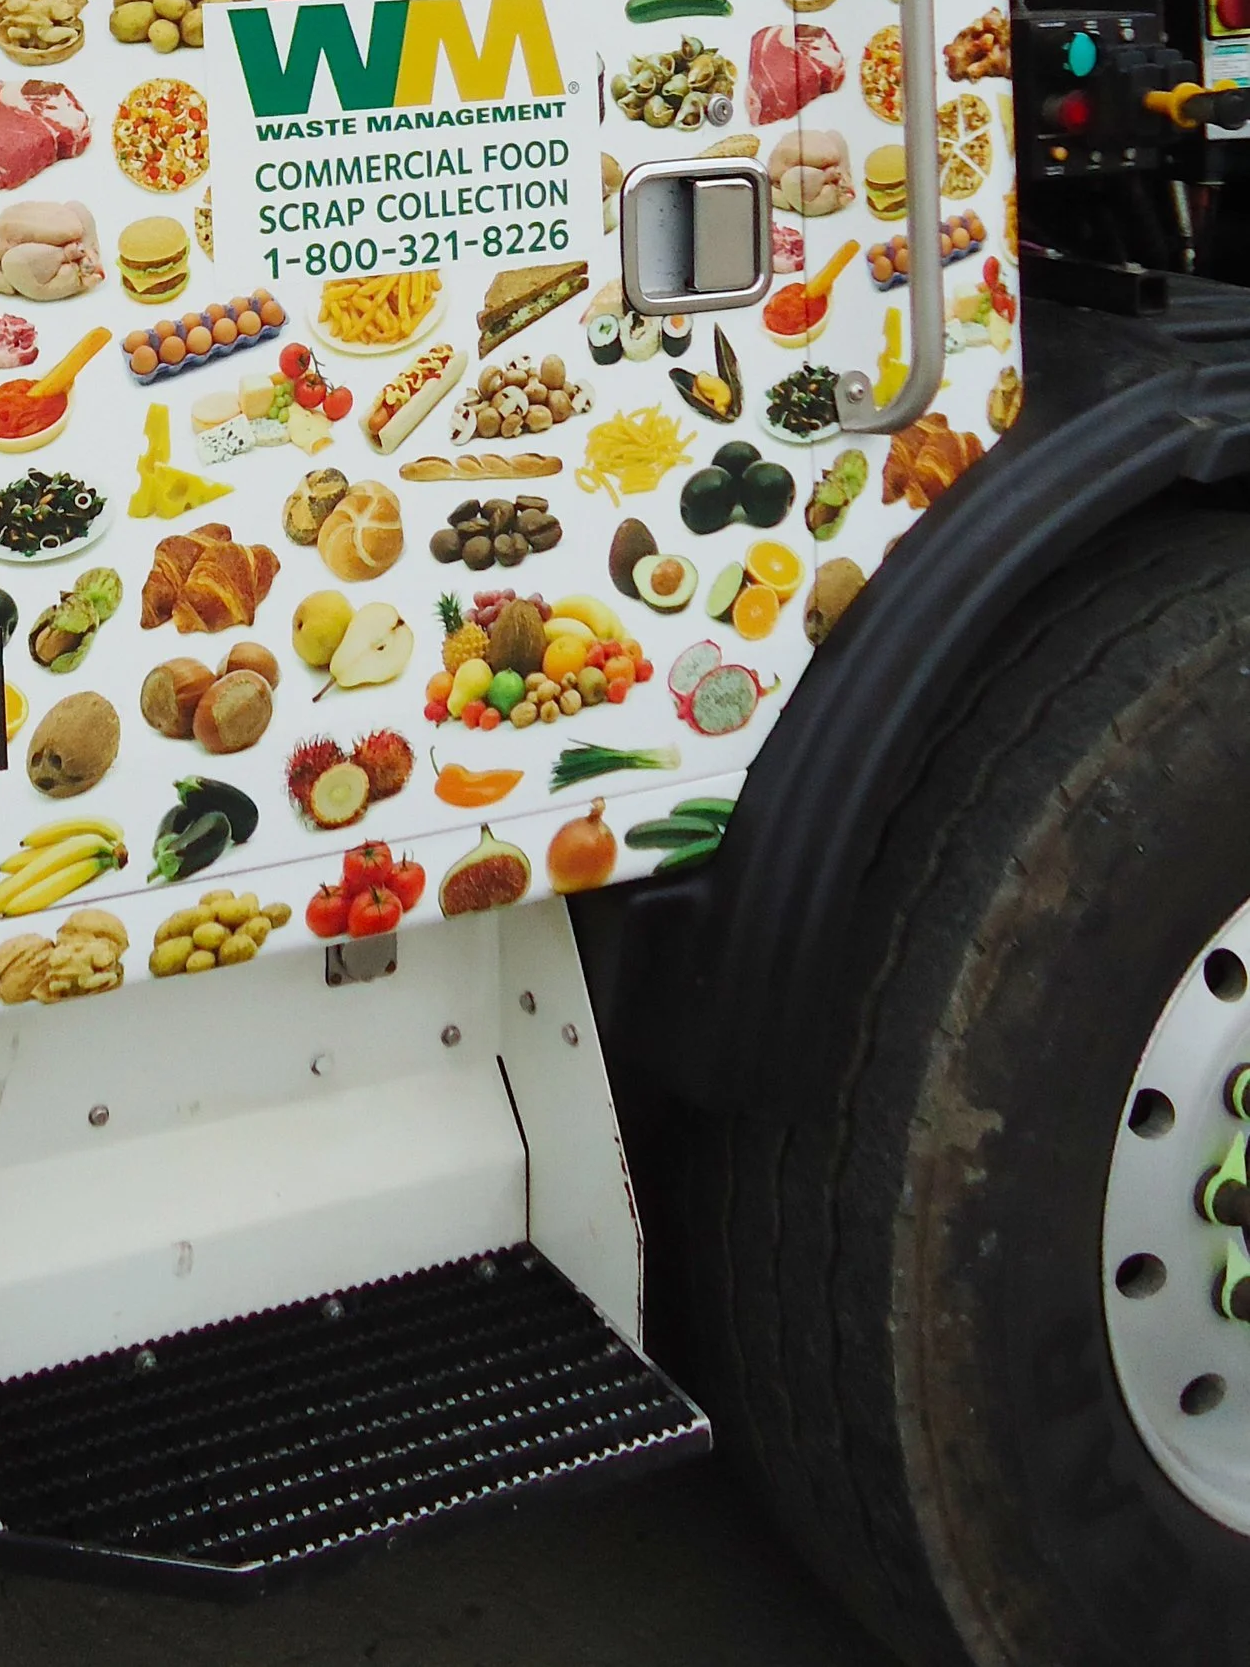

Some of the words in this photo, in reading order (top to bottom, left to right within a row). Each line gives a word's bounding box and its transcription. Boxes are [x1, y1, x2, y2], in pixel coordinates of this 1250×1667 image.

[255, 117, 357, 141] WASTE
[366, 101, 567, 133] MANAGEMENT
[255, 148, 473, 192] COMMERCIAL
[483, 139, 569, 172] FOOD
[259, 197, 365, 234] SCRAP
[376, 179, 569, 223] COLLECTION
[262, 219, 569, 280] 1-800-321-8226
